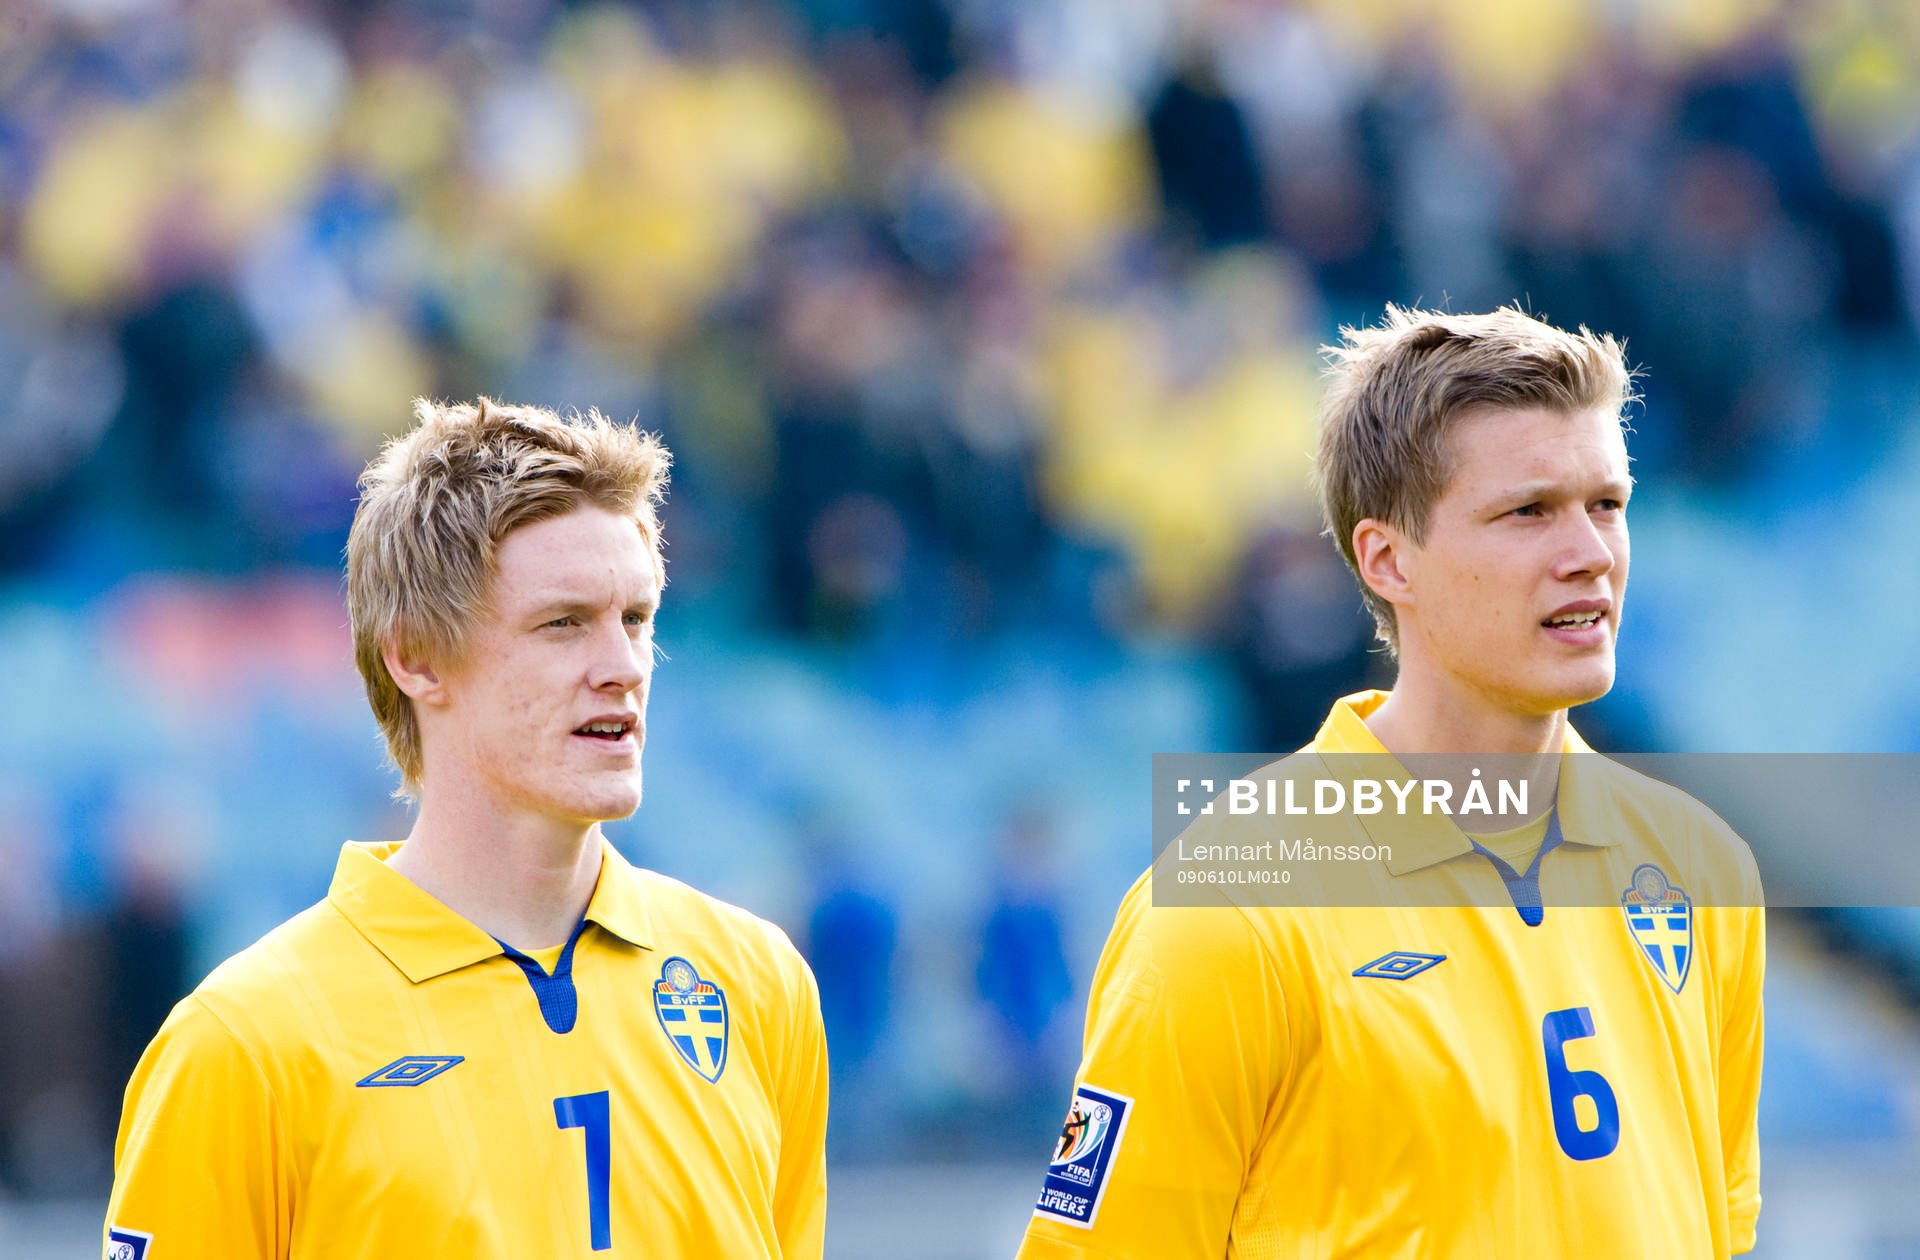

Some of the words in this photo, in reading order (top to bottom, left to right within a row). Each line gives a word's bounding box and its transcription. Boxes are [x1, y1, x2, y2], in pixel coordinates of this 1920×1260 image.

[671, 995, 705, 1005] SvFF
[1542, 1006, 1620, 1161] 6
[1067, 1164, 1090, 1178] FIFA
[1047, 1188, 1073, 1201] WORLD
[1073, 1196, 1089, 1205] CUP
